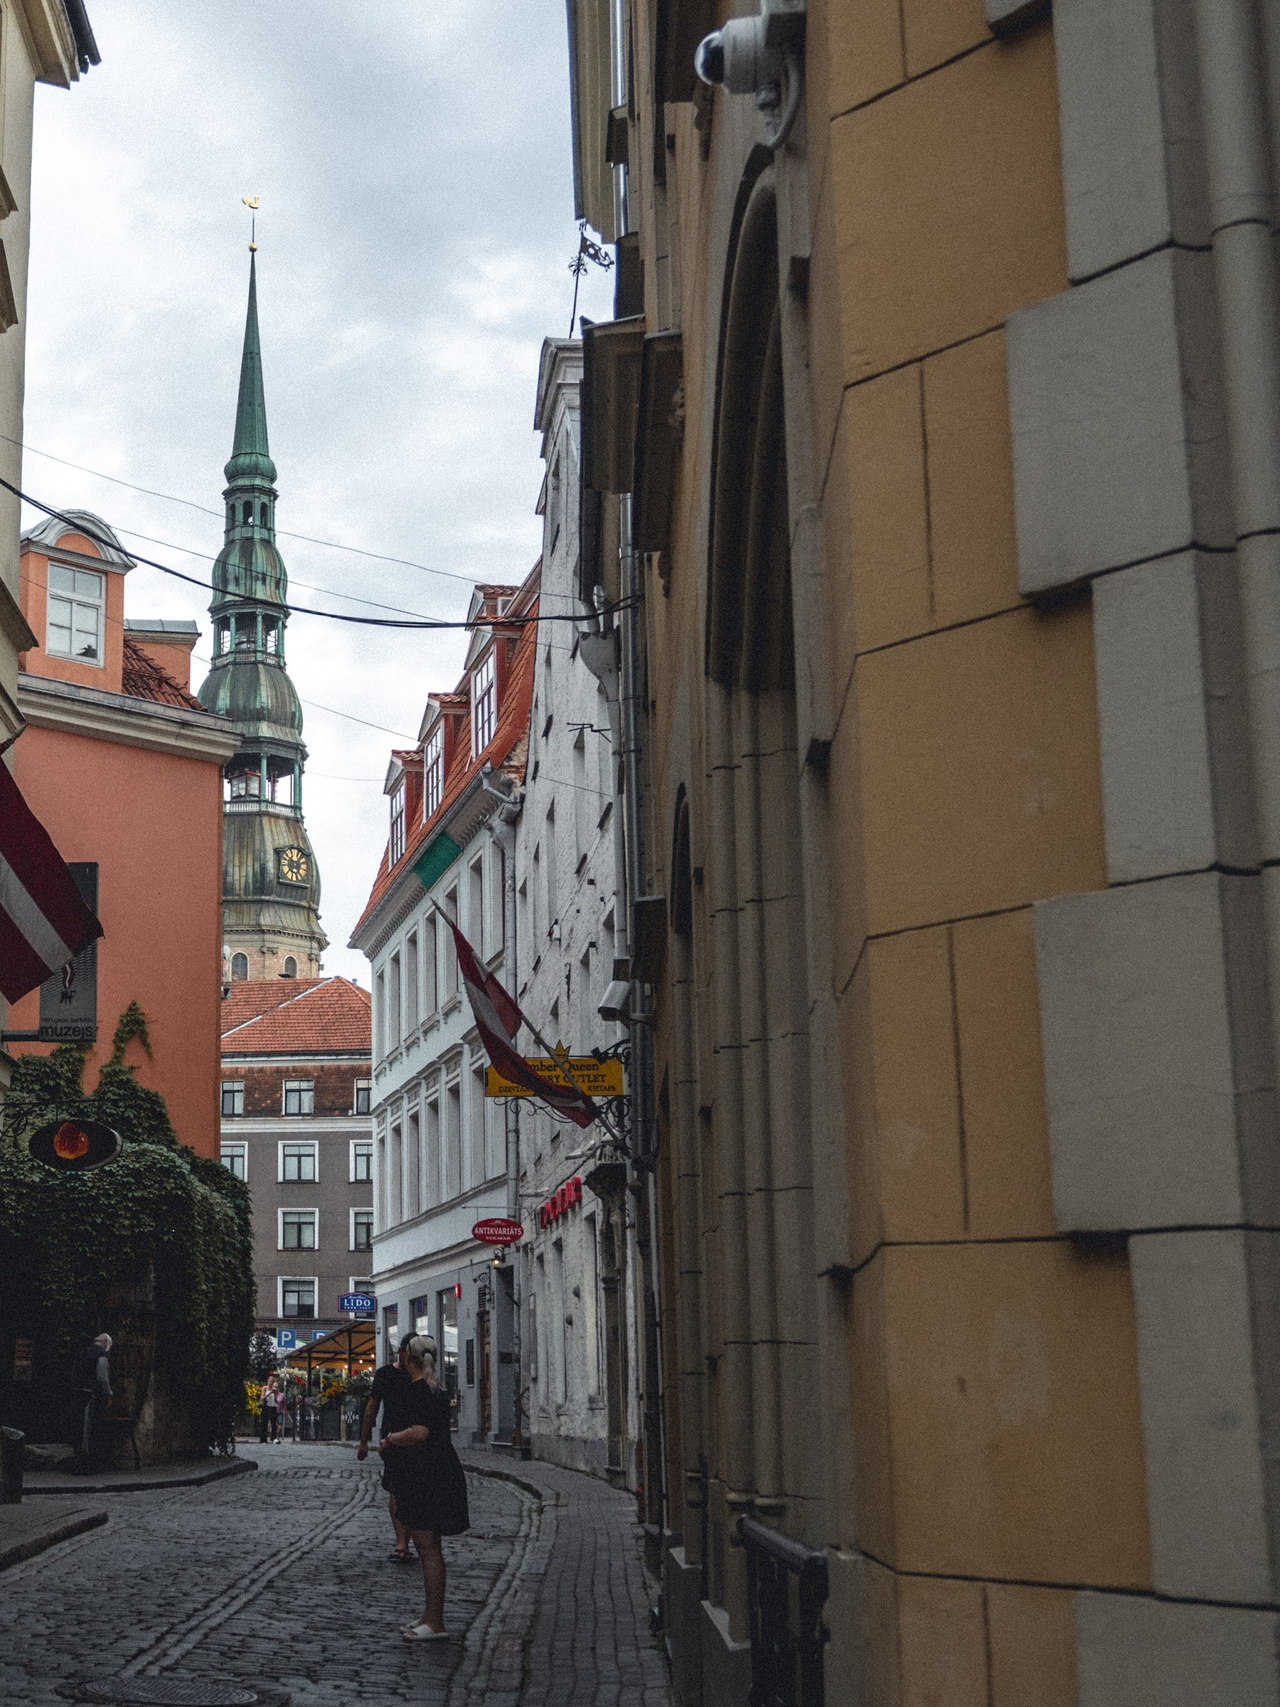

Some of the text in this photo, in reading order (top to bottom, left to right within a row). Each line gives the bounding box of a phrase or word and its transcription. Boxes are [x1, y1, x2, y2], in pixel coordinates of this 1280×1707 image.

[40, 1025, 93, 1039] muzejs
[531, 1060, 599, 1072] mber Queen
[474, 1226, 522, 1236] ANTIKVARIĀTS
[344, 1298, 371, 1307] LIDO
[281, 1331, 292, 1346] P
